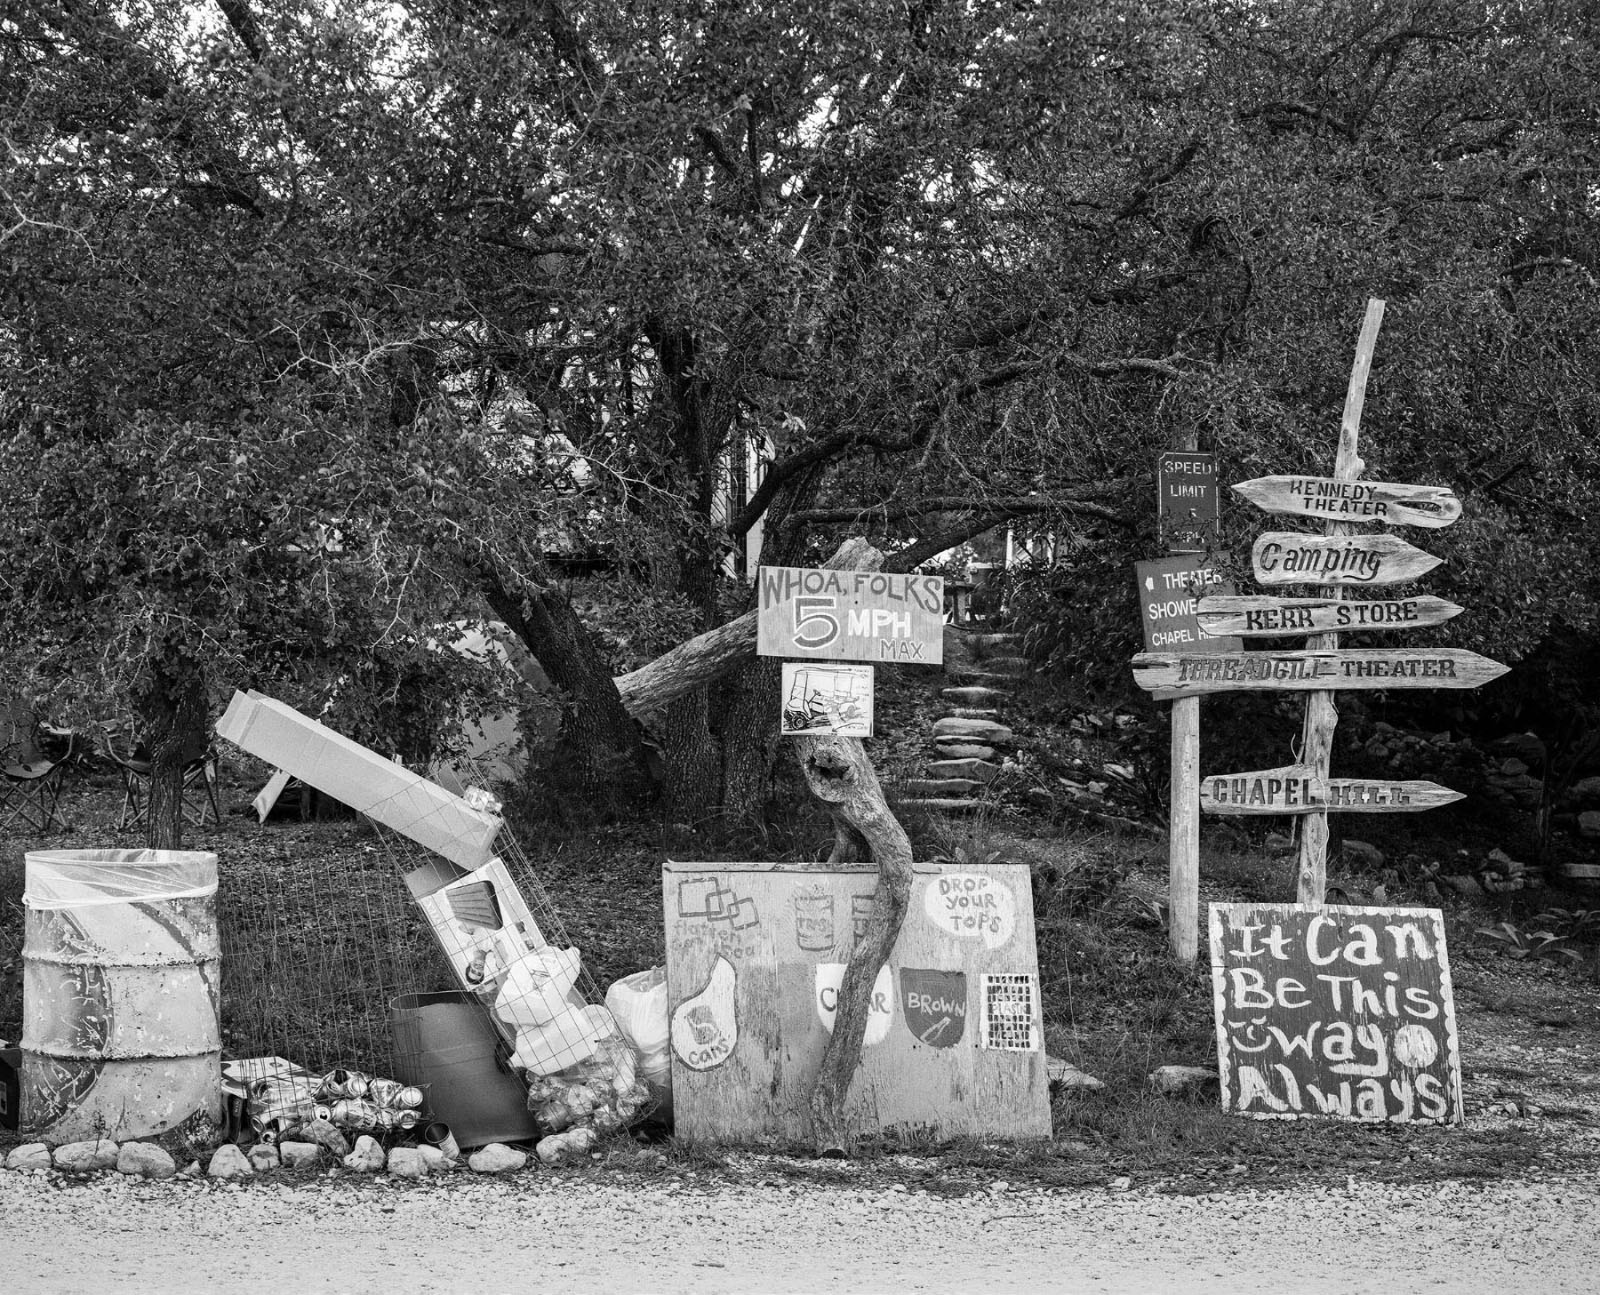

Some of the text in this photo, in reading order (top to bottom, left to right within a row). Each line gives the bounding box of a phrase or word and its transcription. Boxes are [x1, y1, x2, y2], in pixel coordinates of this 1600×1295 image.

[1164, 461, 1212, 475] SPEED
[1170, 485, 1206, 498] LIMIT
[1289, 480, 1377, 500] KENNEDY
[1303, 498, 1387, 517] THEATER
[1260, 541, 1381, 582] Camping
[761, 567, 942, 614] WHOA, FOLKS
[1149, 598, 1198, 620] SHOWE
[1246, 601, 1419, 631] KERR STORE
[792, 595, 841, 650] 5
[847, 608, 912, 639] MPH
[1152, 629, 1195, 646] CHAPEL
[1340, 659, 1457, 677] THEATER
[1212, 778, 1410, 806] CHAPEL HILL
[939, 878, 990, 896] DROP
[950, 911, 1002, 933] TOPS
[1228, 915, 1434, 966] It Can
[1229, 967, 1439, 1020] Be This
[1236, 1063, 1448, 1123] Always
